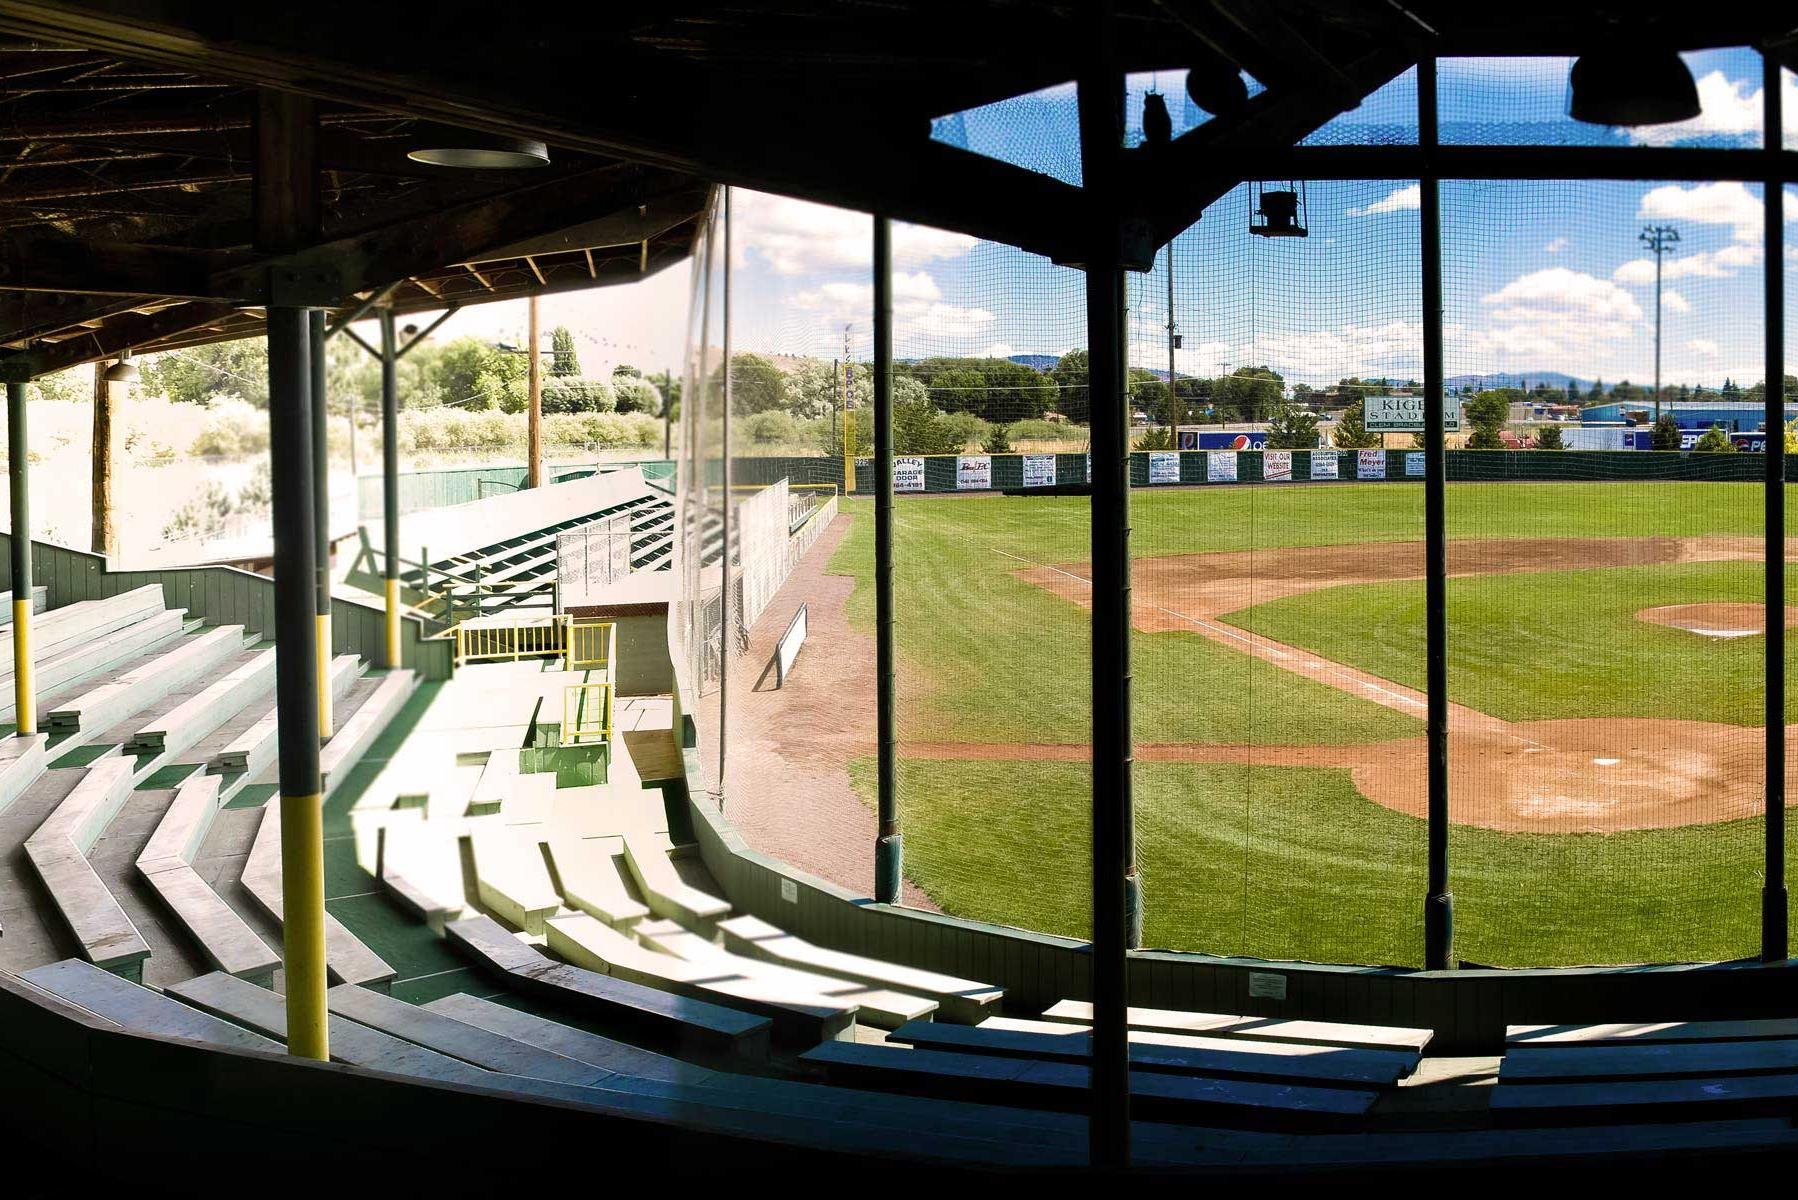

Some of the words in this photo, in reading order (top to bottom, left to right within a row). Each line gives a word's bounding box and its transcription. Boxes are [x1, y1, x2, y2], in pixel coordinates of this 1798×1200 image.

[1382, 399, 1425, 411] KIGE
[1369, 412, 1454, 420] STADM
[1264, 452, 1278, 461] VISIT
[1278, 452, 1291, 461] OUR
[1359, 450, 1378, 458] Fred
[1359, 458, 1385, 467] Meyer
